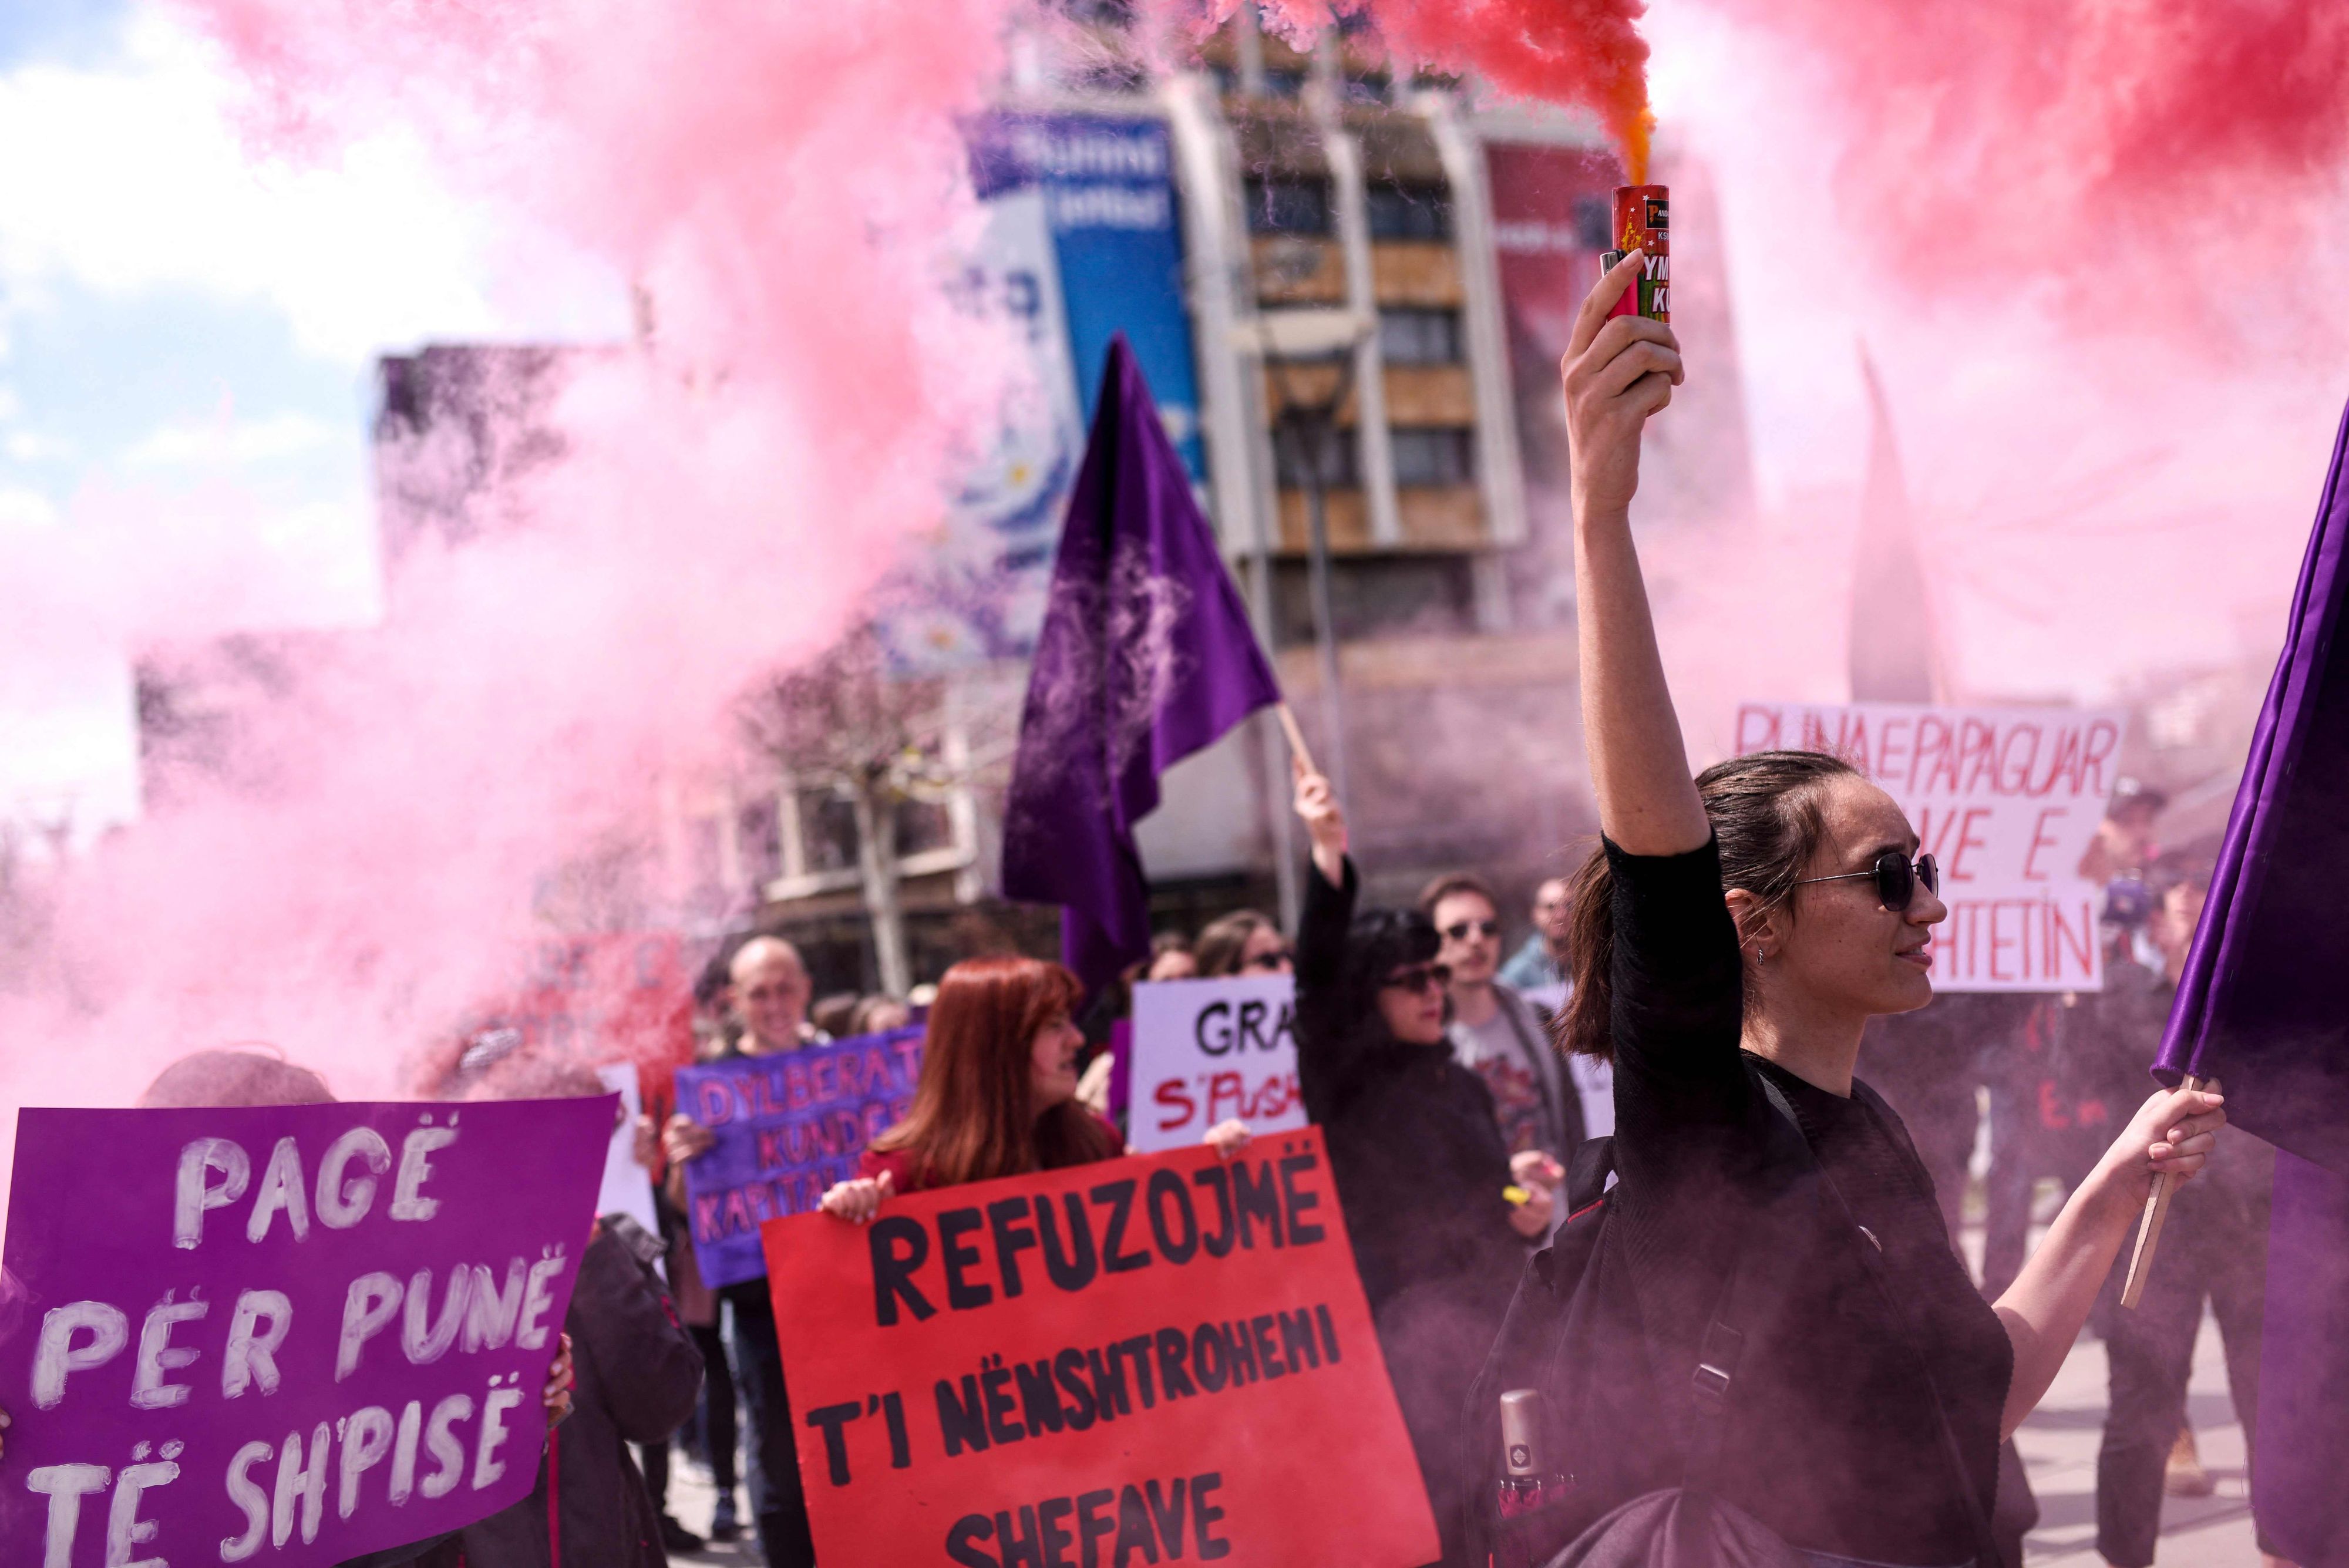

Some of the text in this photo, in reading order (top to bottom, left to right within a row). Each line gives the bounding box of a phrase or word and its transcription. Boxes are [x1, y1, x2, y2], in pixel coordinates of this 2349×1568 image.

[173, 1111, 459, 1250] PAGË
[868, 1141, 1325, 1326] REFUZOJMË
[31, 1242, 567, 1409] PËR PUNË
[806, 1304, 1341, 1486] T'I NËNSHTROHEMI
[27, 1438, 184, 1568] TË
[944, 1472, 1231, 1568] SHEFAVE
